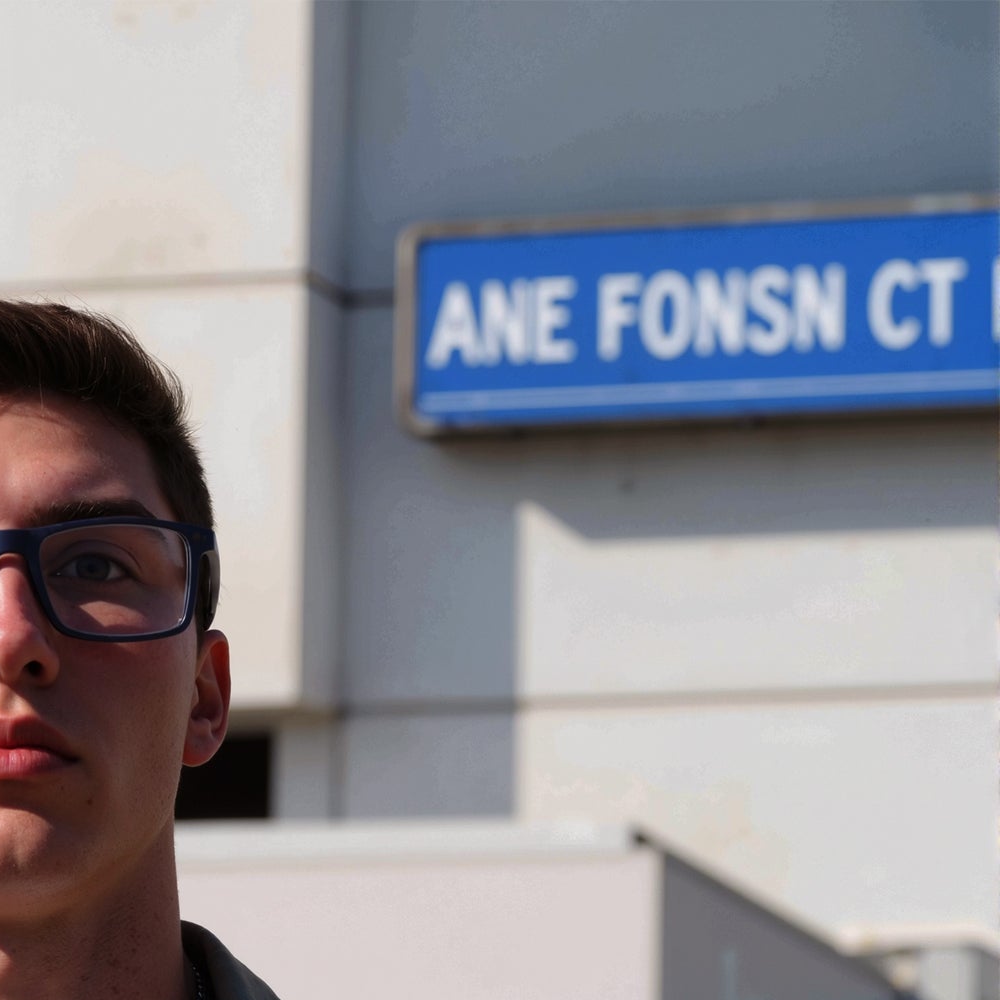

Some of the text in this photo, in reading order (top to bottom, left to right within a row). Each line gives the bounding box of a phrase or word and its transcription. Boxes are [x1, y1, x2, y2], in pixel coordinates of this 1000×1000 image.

[426, 275, 576, 367] ANE
[598, 264, 846, 361] FONSN
[867, 257, 967, 349] CT
